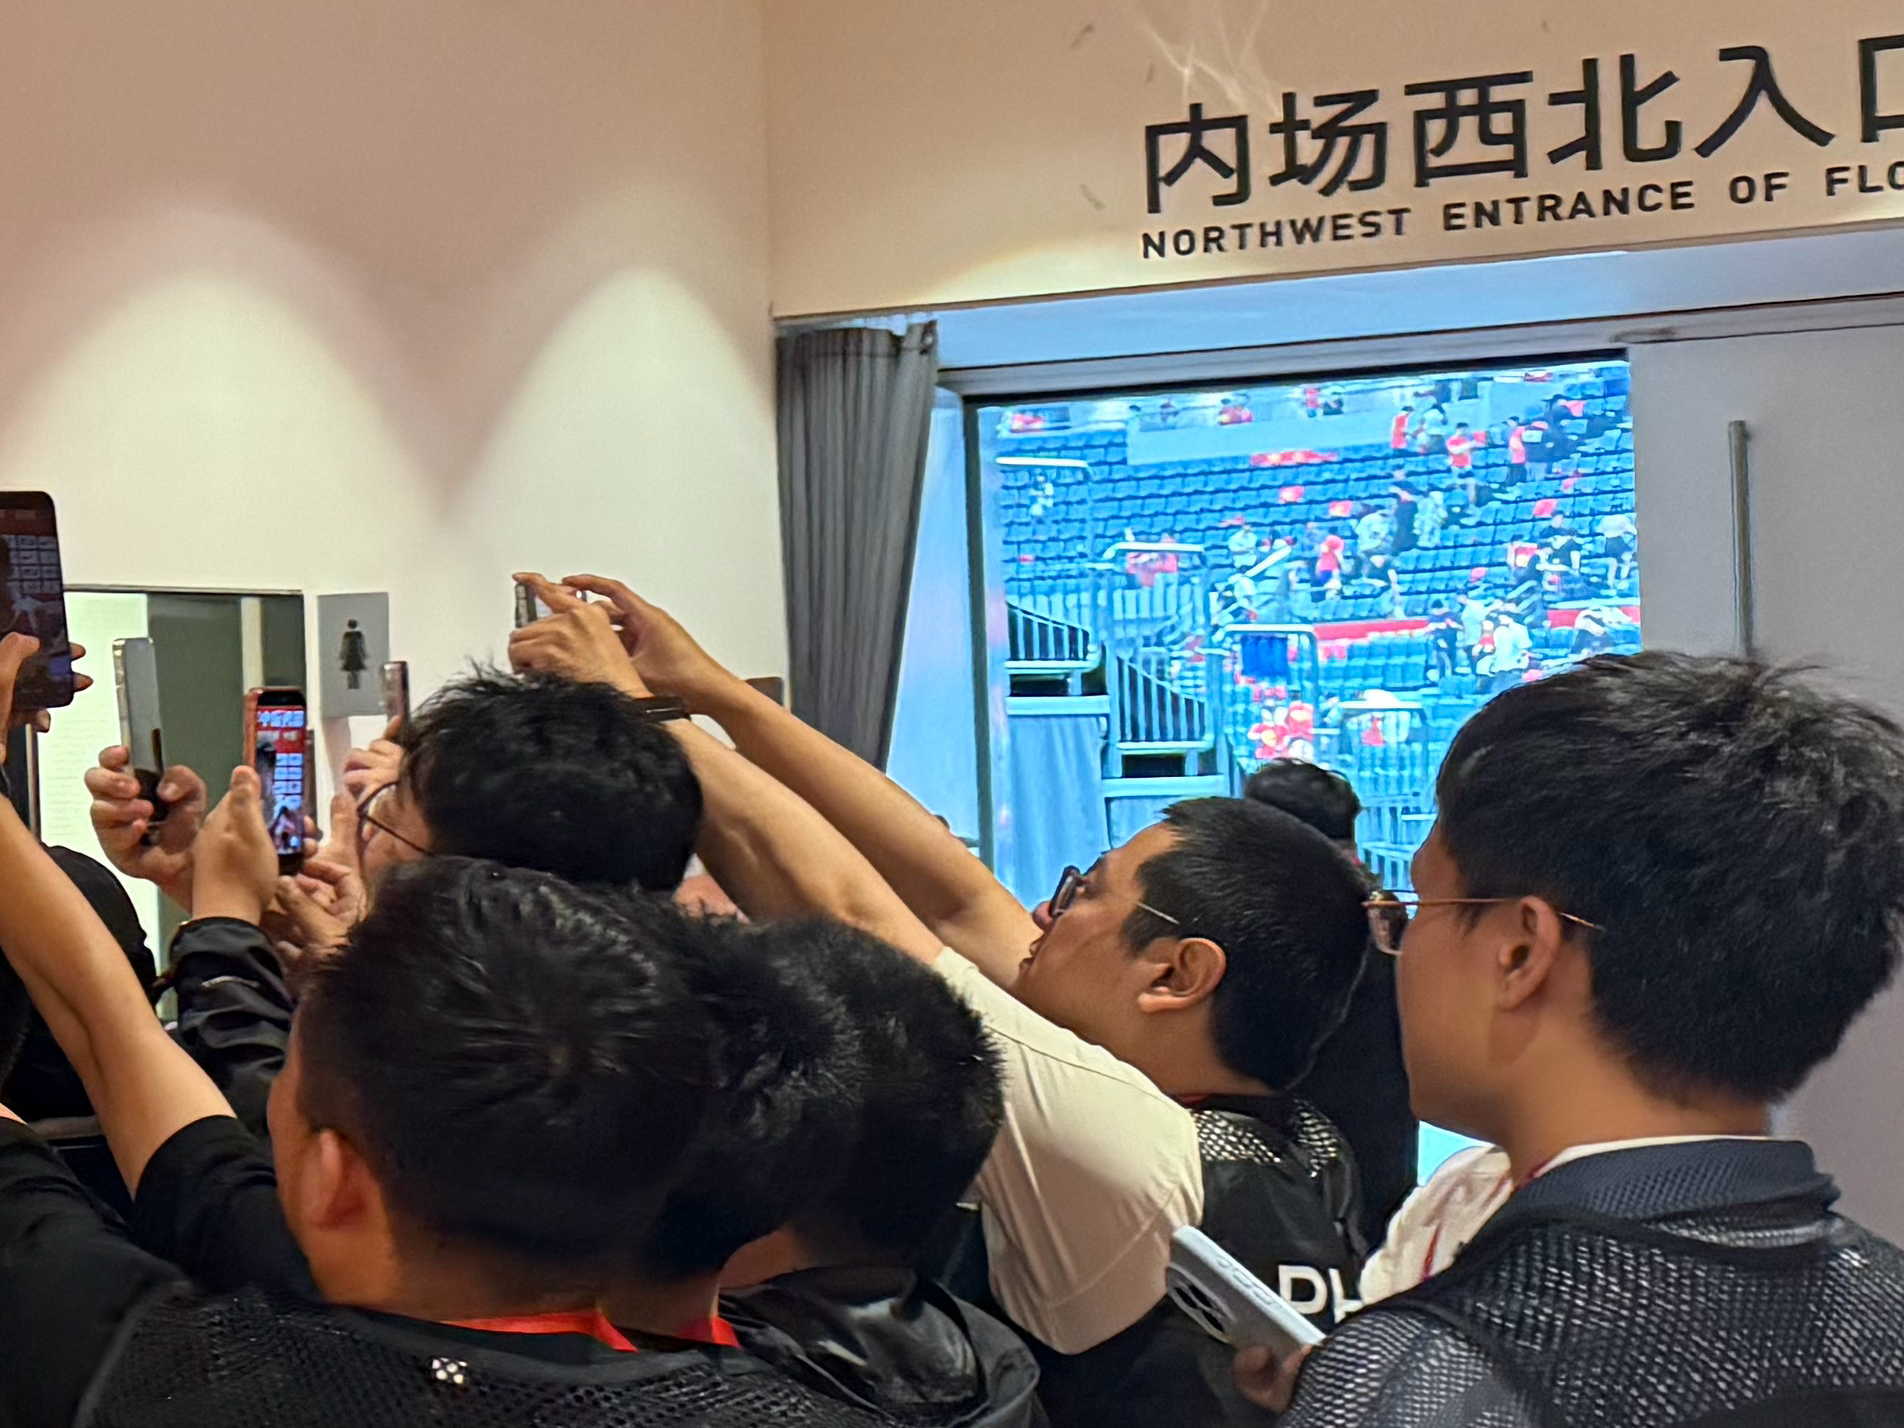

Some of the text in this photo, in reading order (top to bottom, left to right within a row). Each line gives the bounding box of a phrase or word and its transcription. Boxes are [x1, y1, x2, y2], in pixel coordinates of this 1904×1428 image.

[1142, 207, 1412, 260] NORTHWEST
[1443, 179, 1696, 232] ENTRANCE
[1728, 172, 1790, 205] OF
